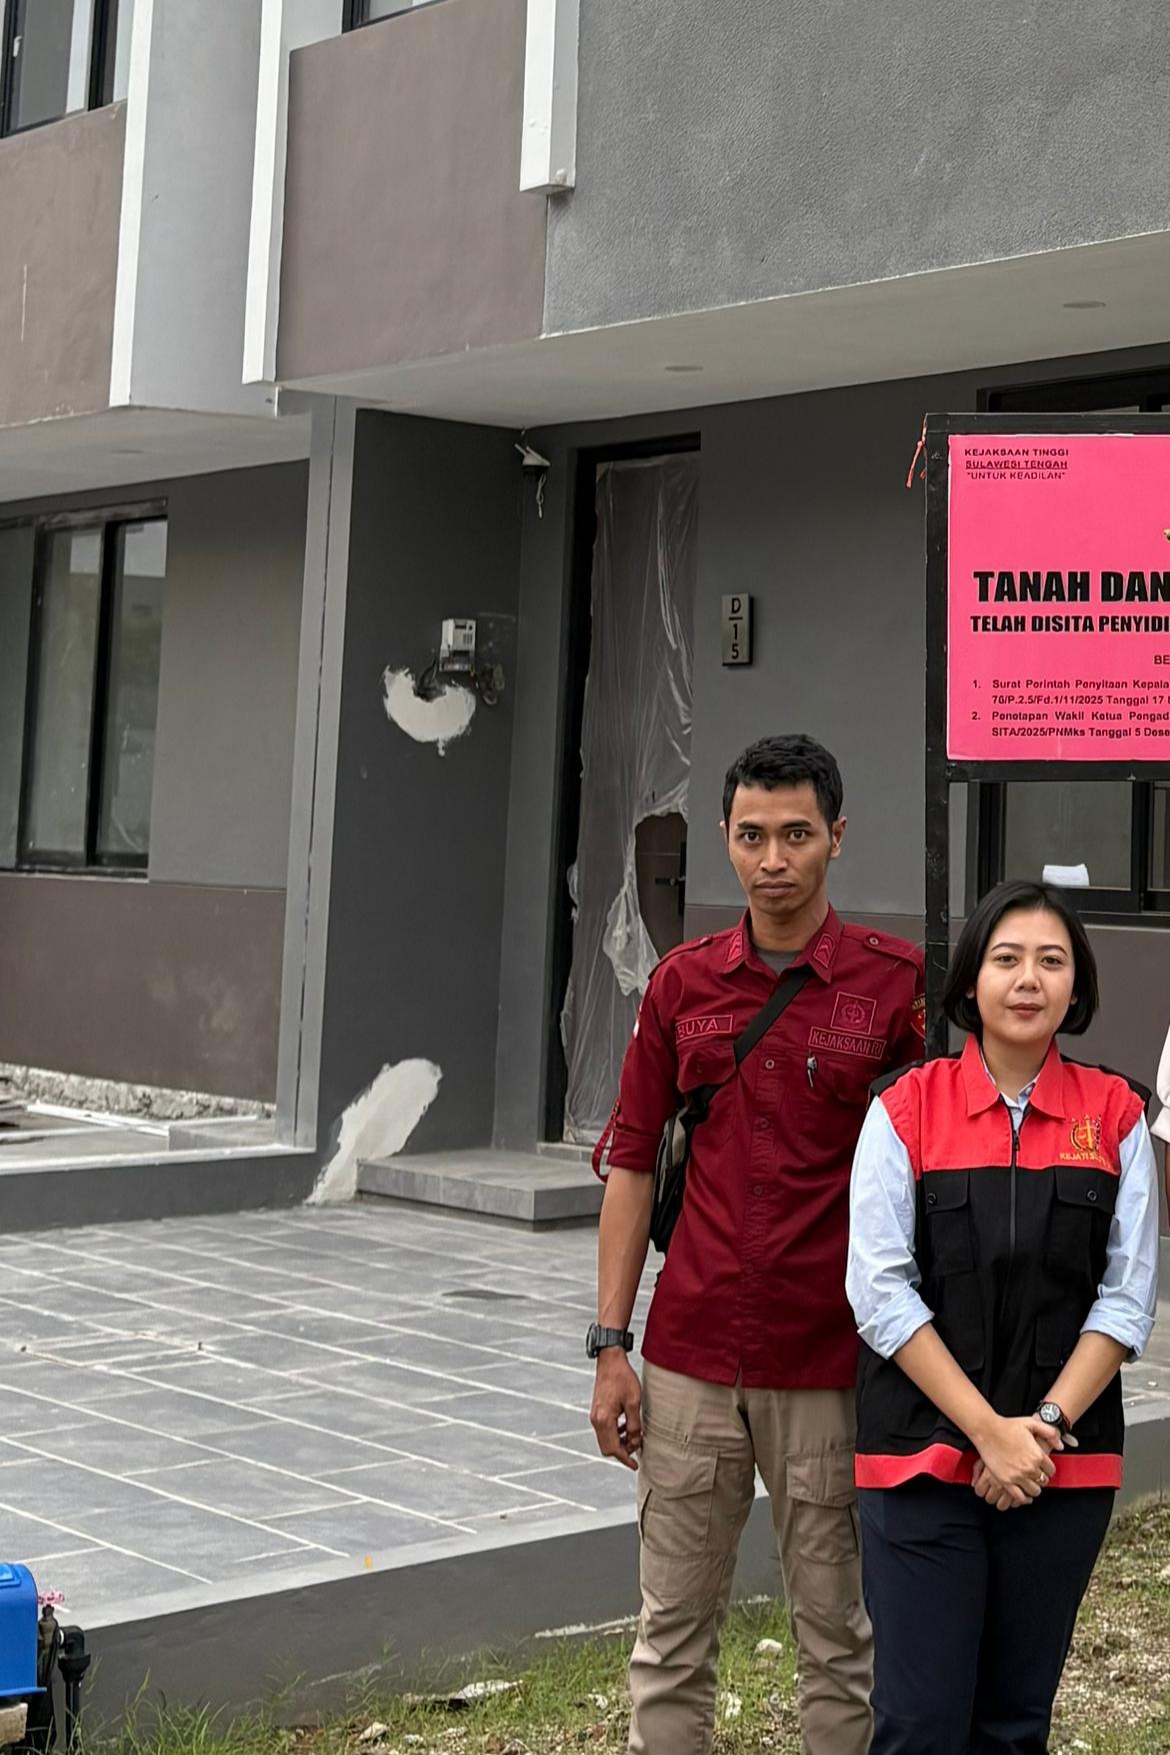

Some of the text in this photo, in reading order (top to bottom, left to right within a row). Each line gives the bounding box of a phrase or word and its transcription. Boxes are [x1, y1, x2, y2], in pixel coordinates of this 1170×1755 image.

[964, 448, 1069, 457] KEJAKSAAN TINGGI
[965, 460, 1068, 470] SULAWESI TENGAH
[973, 571, 1090, 603] TANAH
[731, 597, 742, 614] D
[970, 615, 1026, 632] TELAH
[1031, 615, 1095, 632] DISITA
[972, 679, 981, 689] 1.
[992, 679, 1021, 689] Surat
[1025, 679, 1071, 689] Perintah
[1075, 679, 1128, 692] Penyitaan
[1132, 679, 1170, 692] Kepala
[1106, 695, 1149, 707] Tanggal
[1152, 695, 1164, 705] 17
[971, 711, 981, 721] 2.
[991, 711, 1049, 723] Penetapan
[1054, 711, 1085, 721] Wakil
[1091, 711, 1123, 721] Ketua
[991, 727, 1086, 737] SITA/2025/PNMks
[1088, 727, 1132, 739] Tanggal
[1134, 727, 1141, 737] 5
[677, 1018, 718, 1038] BUYA
[811, 1031, 871, 1054] KEJAKSAAN
